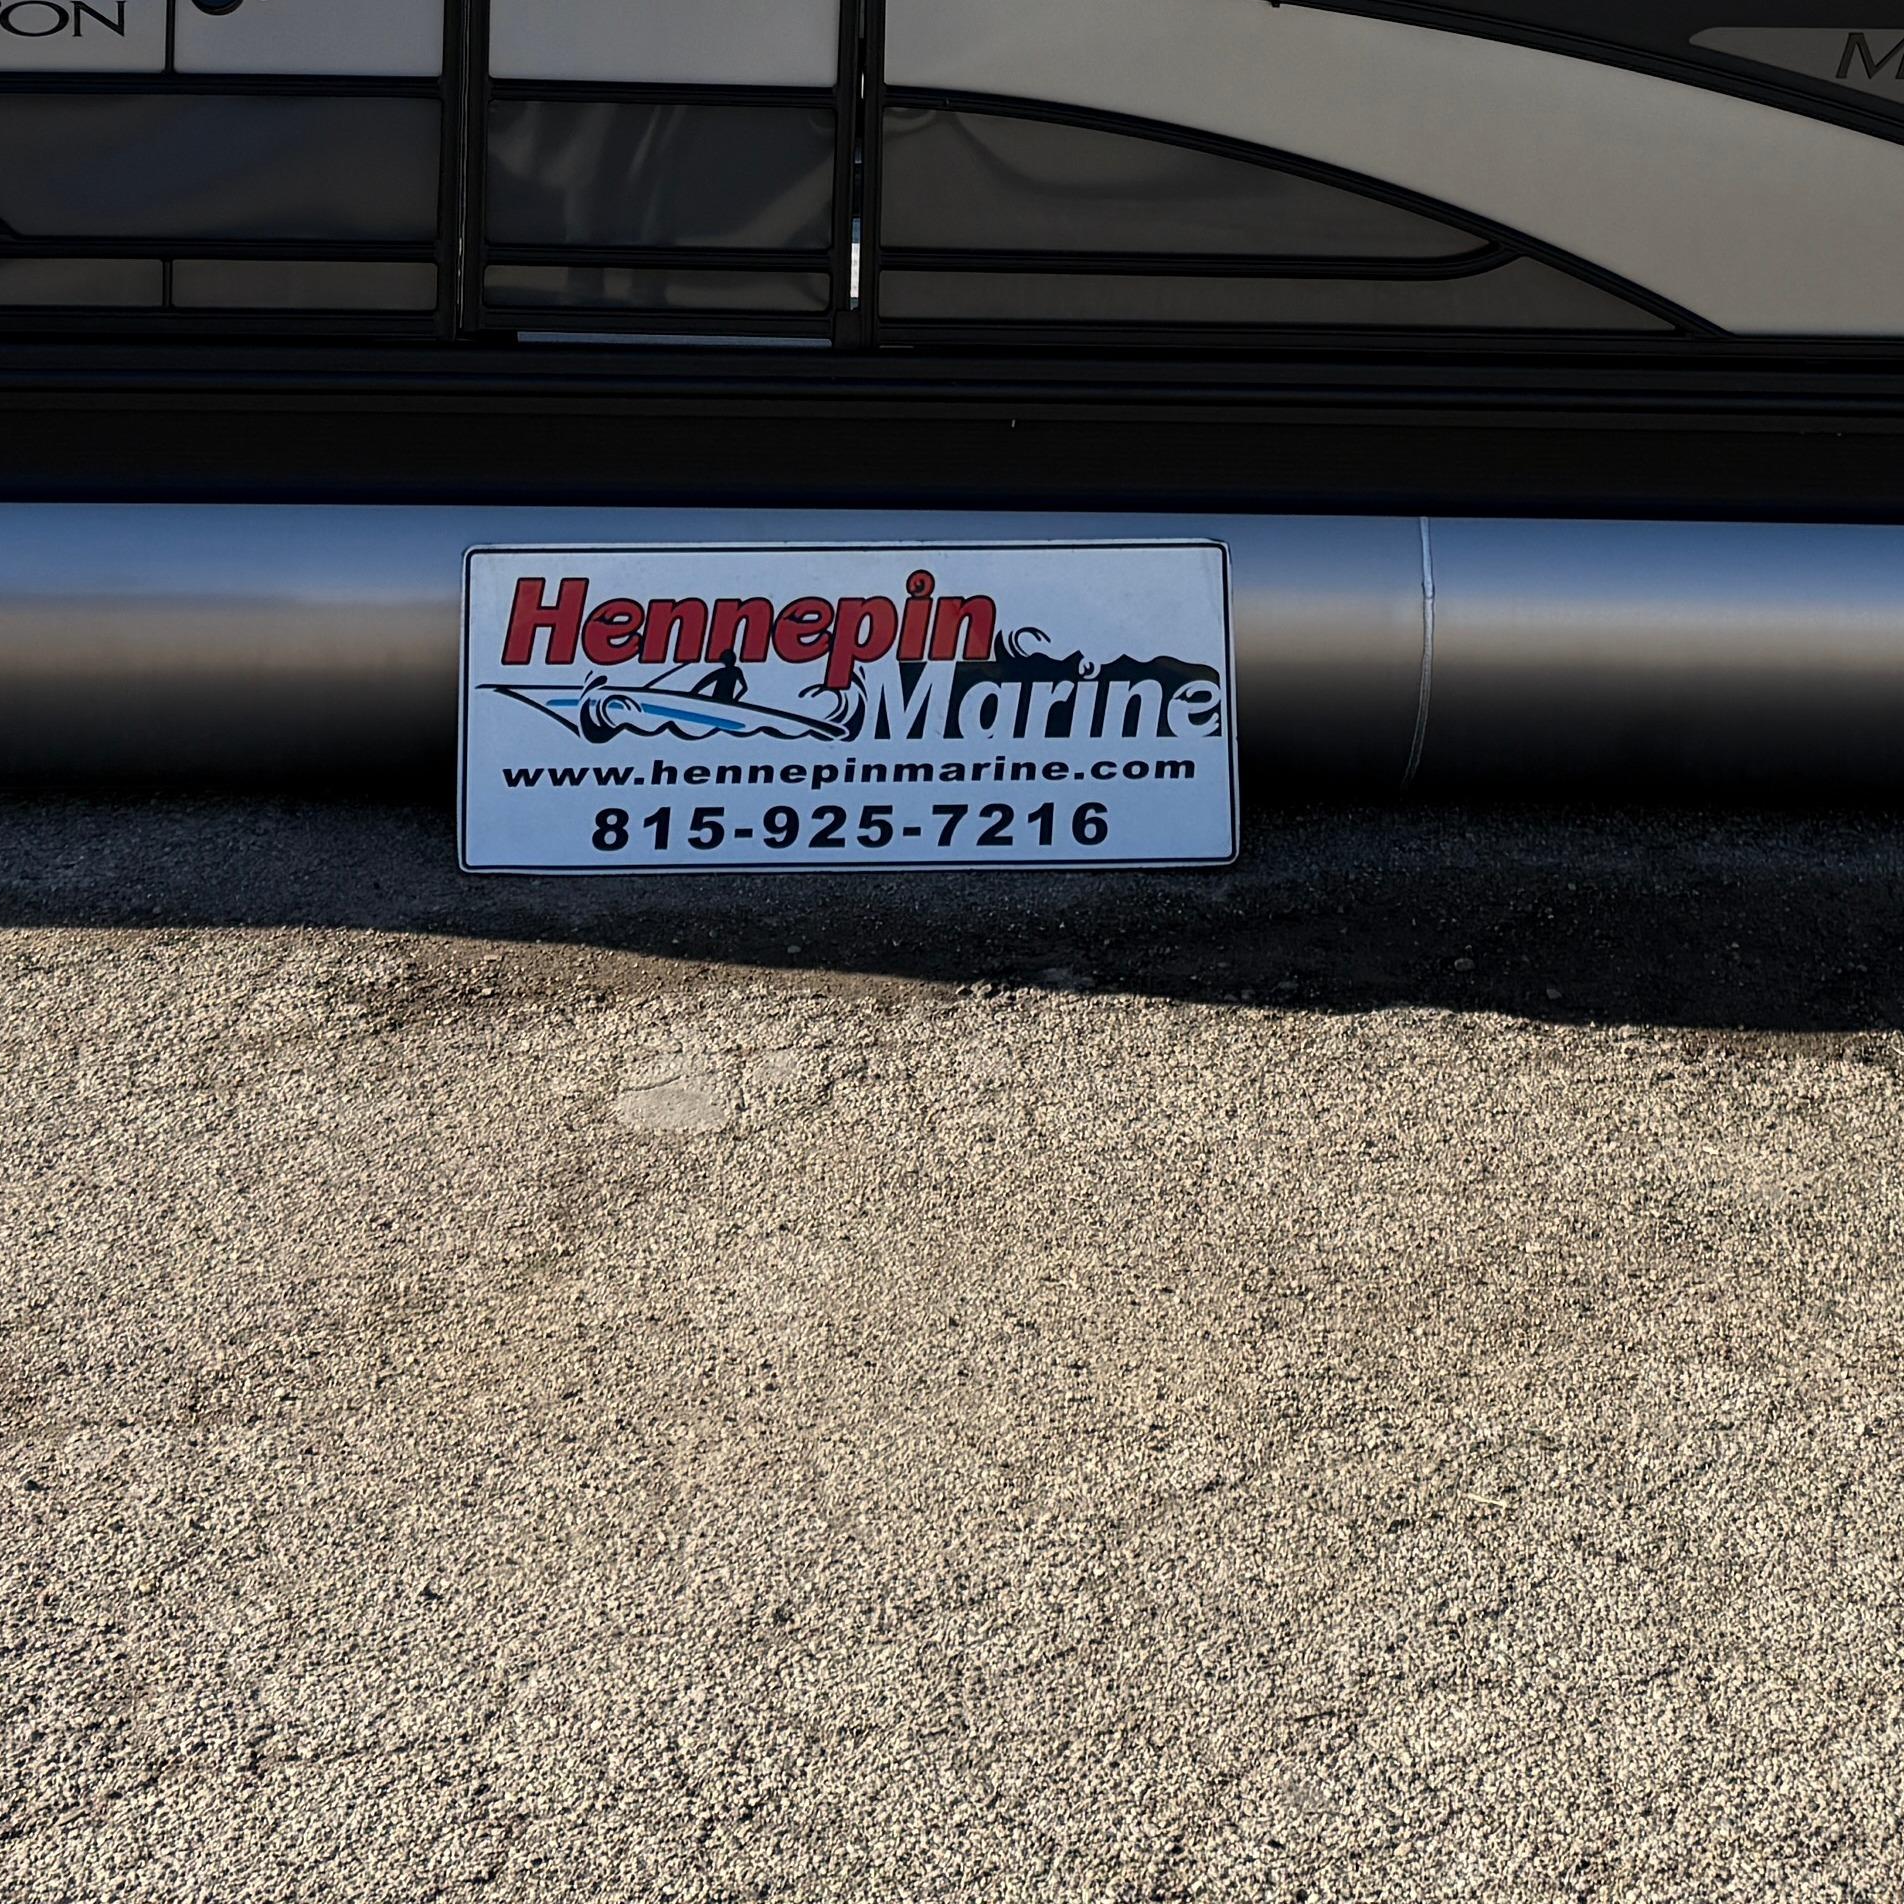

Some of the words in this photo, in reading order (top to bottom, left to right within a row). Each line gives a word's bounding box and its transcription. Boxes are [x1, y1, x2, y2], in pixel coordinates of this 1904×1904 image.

[500, 569, 997, 690] Hennepin
[862, 654, 1223, 740] Marine
[502, 756, 1196, 791] www.hennepinmarine.com
[591, 801, 1109, 852] 815-925-7216
